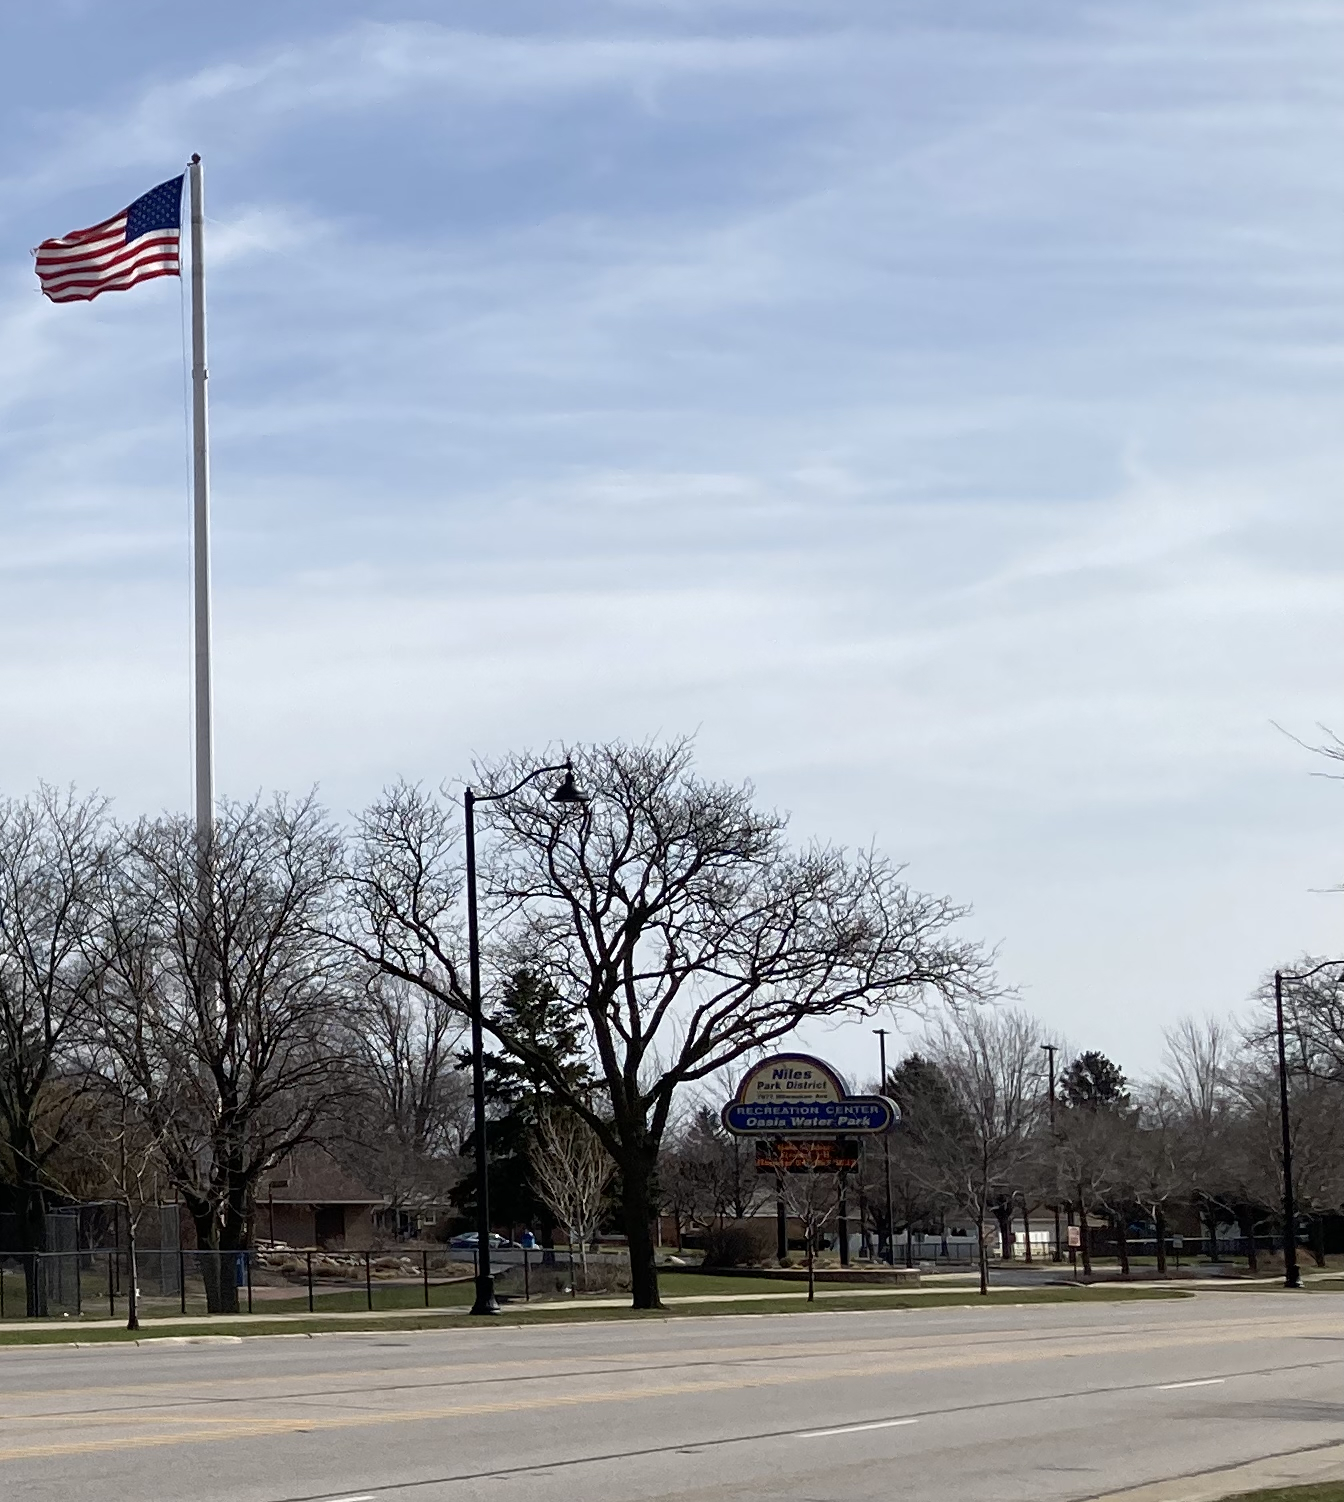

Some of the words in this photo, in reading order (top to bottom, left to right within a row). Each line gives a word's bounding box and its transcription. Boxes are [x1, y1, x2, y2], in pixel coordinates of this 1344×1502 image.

[772, 1069, 813, 1080] Niles
[757, 1081, 781, 1090] Park
[786, 1080, 827, 1090] District
[737, 1106, 820, 1115] RECREATION
[826, 1105, 879, 1115] CENTER
[746, 1116, 787, 1127] Oasis
[791, 1116, 832, 1127] Water
[837, 1116, 871, 1126] Park
